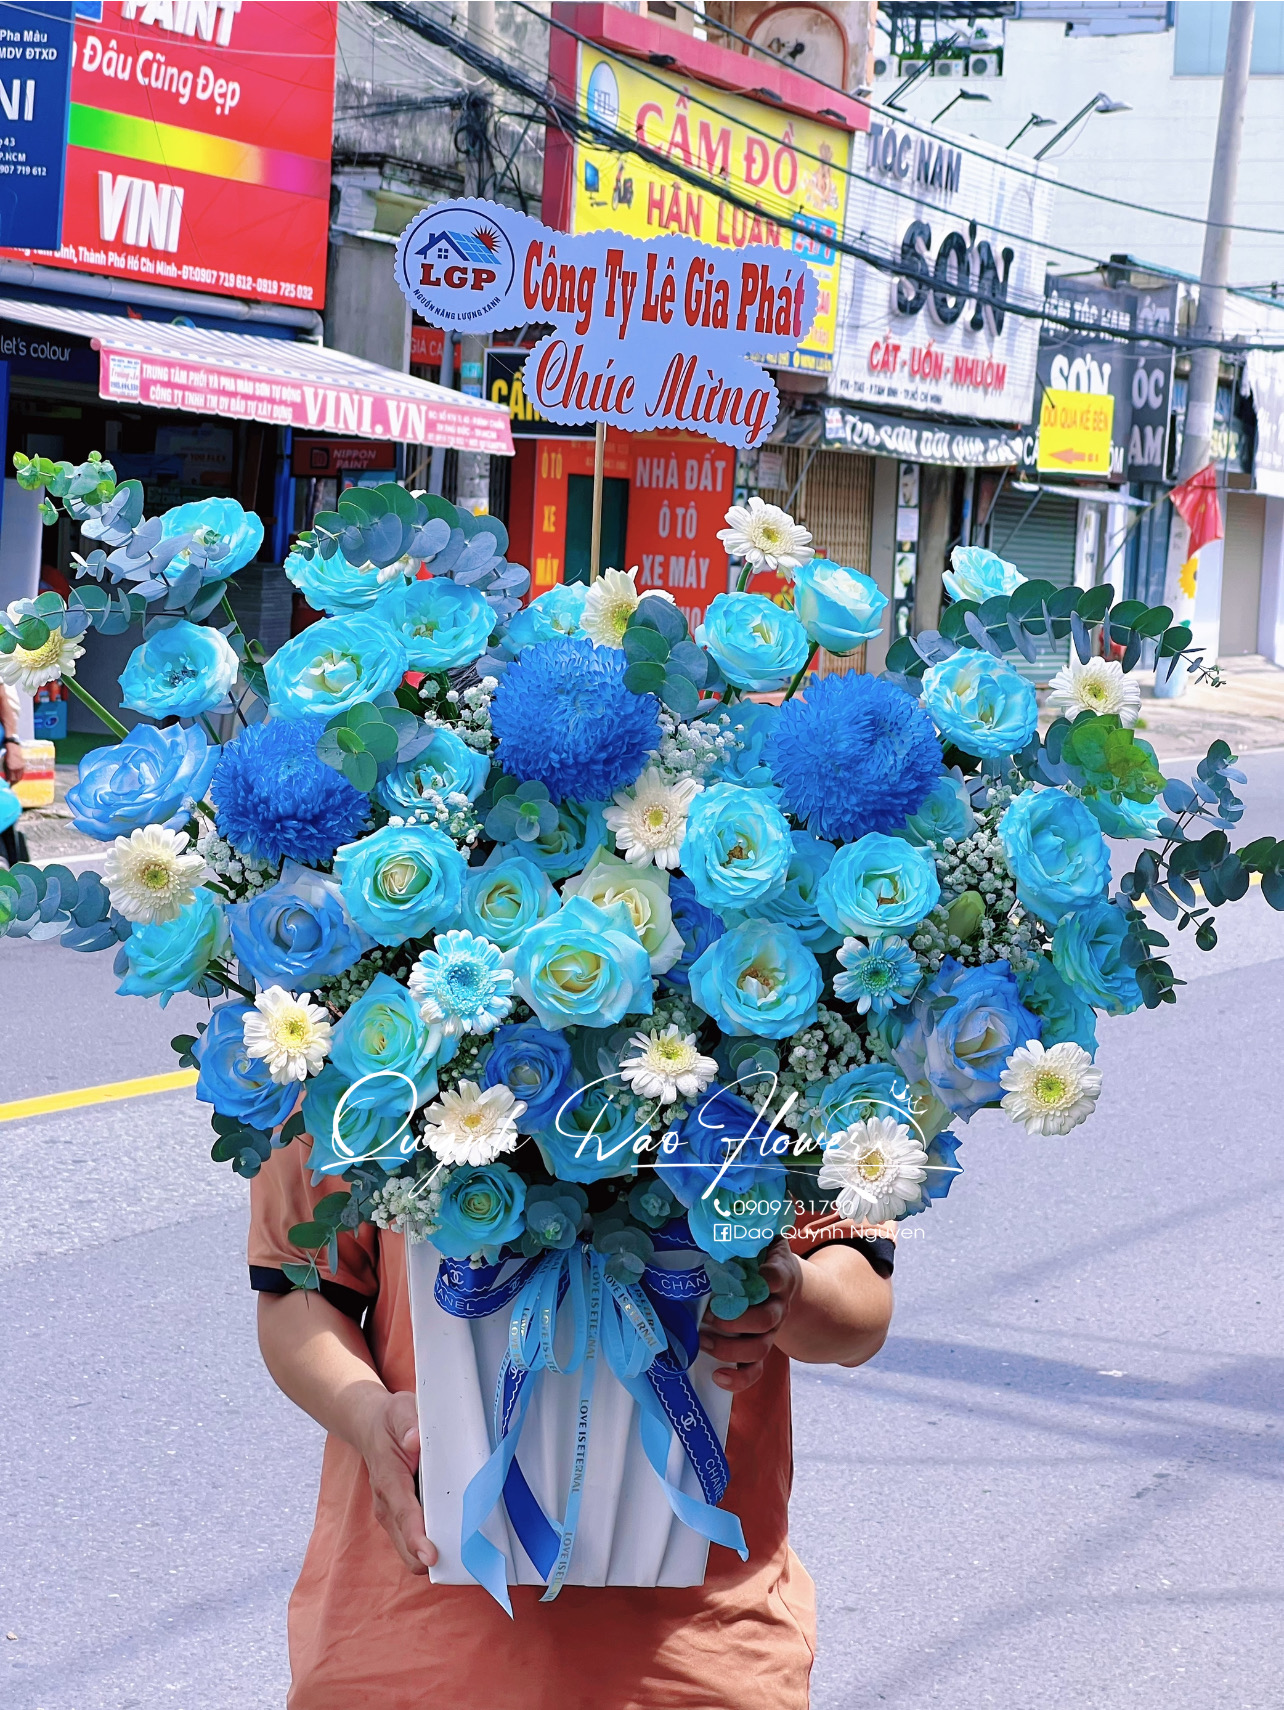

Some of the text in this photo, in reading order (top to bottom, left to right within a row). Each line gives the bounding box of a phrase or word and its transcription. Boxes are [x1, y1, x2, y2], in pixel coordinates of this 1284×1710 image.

[26, 48, 58, 61] ĐTXD
[83, 35, 131, 81] Đâu
[136, 49, 193, 105] Cũng
[196, 65, 241, 115] Đẹp
[743, 120, 799, 196] ĐỒ
[915, 138, 962, 193] NAM
[98, 170, 185, 254] VINI
[78, 246, 106, 266] Thành
[108, 252, 126, 269] Phố
[219, 271, 235, 287] 719
[280, 281, 296, 298] 725
[297, 284, 313, 301] 032
[420, 263, 497, 291] LGP
[524, 239, 806, 340] Công Ty Lê Gia Phát
[892, 218, 1015, 338] SƠN
[482, 296, 501, 314] XANH
[0, 335, 71, 361] let's colour
[143, 363, 169, 382] TRUNG
[171, 366, 188, 385] TÂM
[150, 383, 171, 400] CÔNG
[174, 389, 183, 404] TY
[536, 339, 771, 445] Chúc Mừng
[303, 386, 428, 442] VINI.VN
[333, 448, 377, 460] NIPPON
[336, 459, 369, 469] PAINT
[636, 452, 679, 490] NHÀ
[684, 449, 727, 493] ĐẤT
[542, 505, 556, 533] XE
[658, 499, 698, 540] Ô TÔ
[640, 551, 710, 590] XE MÁY
[578, 1400, 589, 1428] LOVE
[561, 1532, 573, 1559] LOVE
